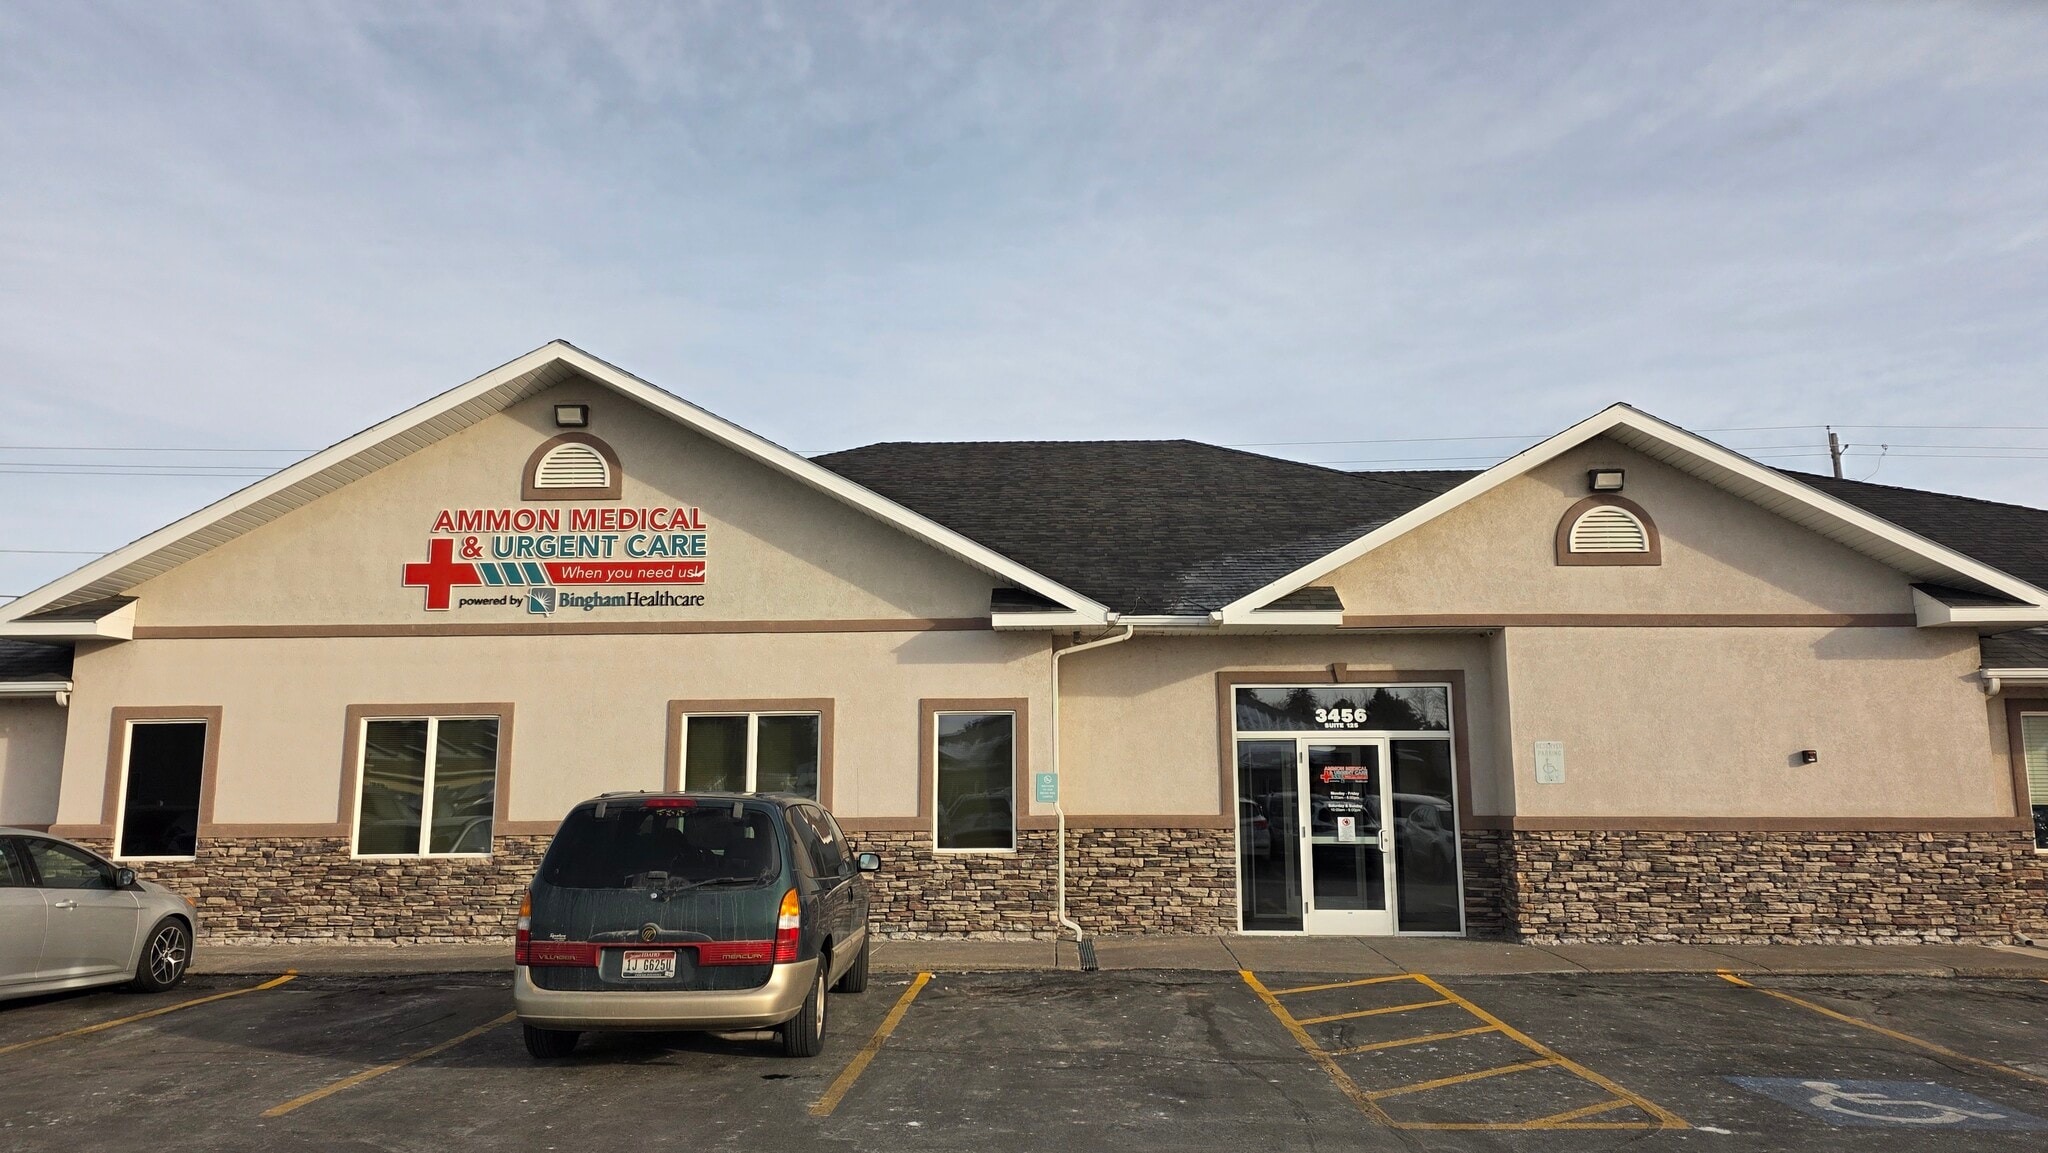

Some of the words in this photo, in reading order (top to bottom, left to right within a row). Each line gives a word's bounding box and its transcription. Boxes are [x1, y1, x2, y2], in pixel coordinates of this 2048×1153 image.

[432, 508, 561, 532] AMMON
[570, 507, 707, 532] MEDICAL
[460, 536, 483, 559] &
[493, 534, 619, 559] URGENT
[626, 533, 707, 558] CARE
[561, 565, 602, 579] When
[606, 568, 633, 582] you
[637, 564, 675, 578] need
[458, 595, 508, 609] powered
[510, 595, 524, 608] by
[558, 590, 705, 611] BinghamHealthcare
[1315, 708, 1367, 723] 3456
[626, 959, 637, 971] 1J
